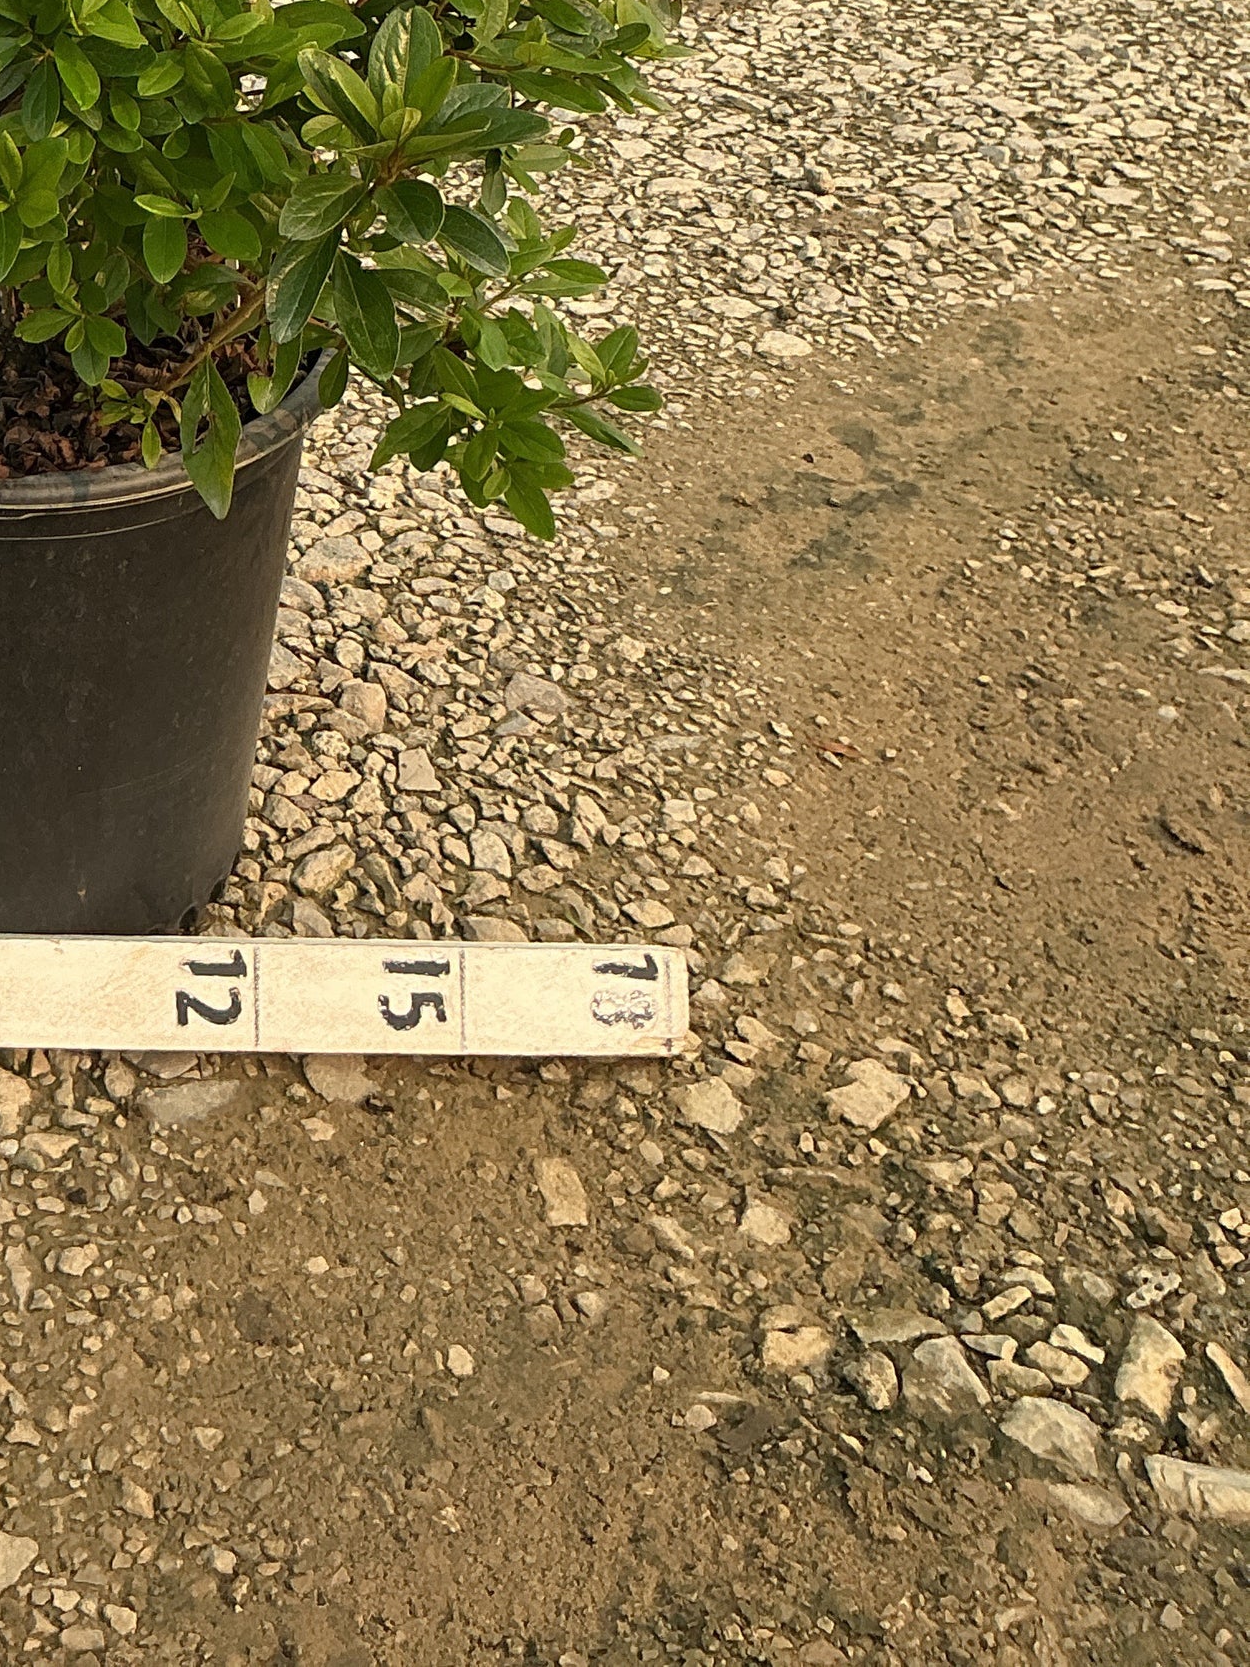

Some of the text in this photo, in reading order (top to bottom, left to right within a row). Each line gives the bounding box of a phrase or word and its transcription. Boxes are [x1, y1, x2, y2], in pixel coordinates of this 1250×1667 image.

[175, 948, 248, 1026] 12
[378, 952, 450, 1031] 15
[591, 953, 658, 1029] 18
